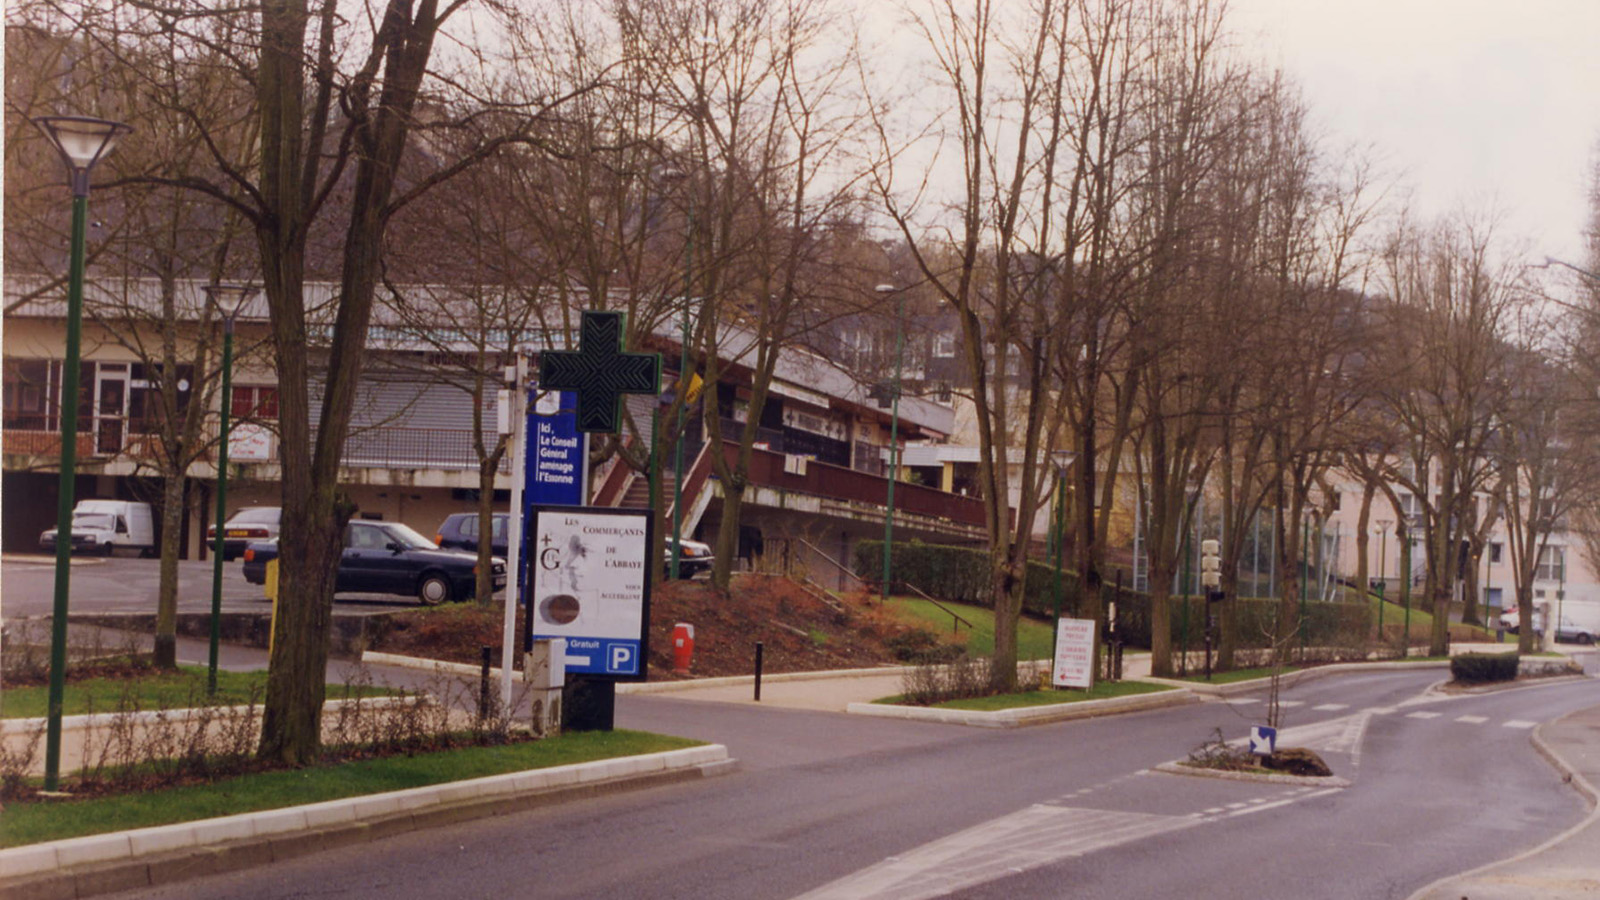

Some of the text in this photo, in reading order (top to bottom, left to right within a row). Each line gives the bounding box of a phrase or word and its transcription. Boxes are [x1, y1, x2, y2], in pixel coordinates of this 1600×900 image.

[540, 435, 578, 448] Le Conseil
[540, 447, 568, 459] Général
[540, 461, 573, 473] aménage
[539, 472, 573, 484] l'Essonne
[570, 639, 600, 649] Gratuit
[612, 647, 630, 669] P
